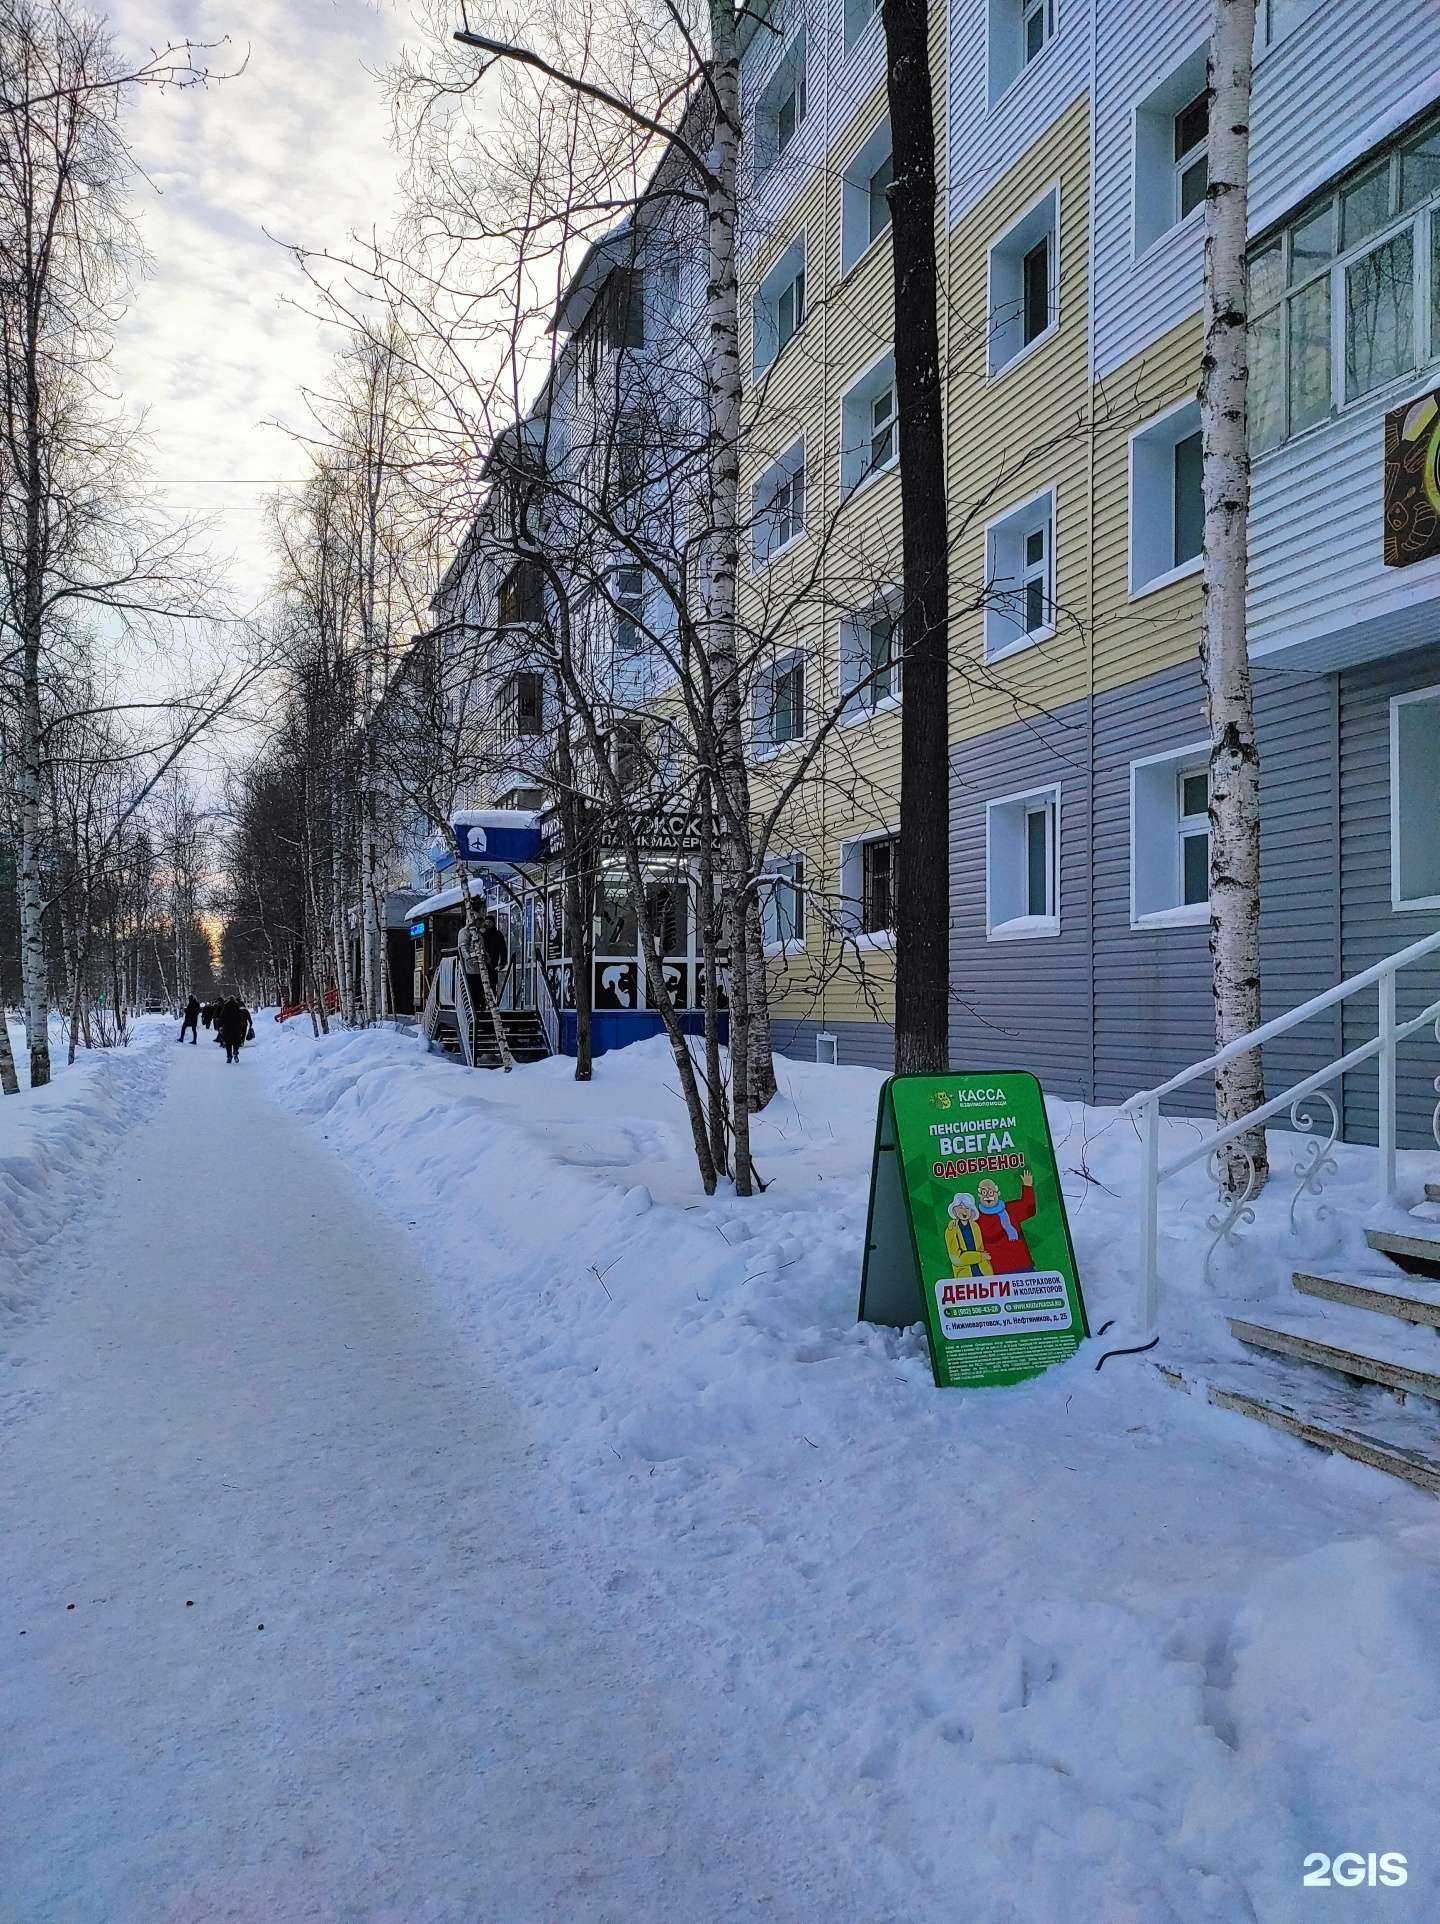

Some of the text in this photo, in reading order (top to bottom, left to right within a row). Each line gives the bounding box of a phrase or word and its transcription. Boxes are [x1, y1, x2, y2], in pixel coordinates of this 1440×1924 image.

[959, 1089, 1006, 1102] КАССА
[929, 1116, 1017, 1136] ПЕНСИОНЕРАМ
[940, 1131, 1015, 1156] ВСЕГДА
[933, 1152, 1025, 1179] ОДОБРЕНО!
[942, 1280, 1011, 1305] ДЕНЬГИ
[1012, 1277, 1061, 1288] БЕЗ СТРАХОВОК
[1013, 1285, 1063, 1296] И КОЛЛЕКТОРОВ
